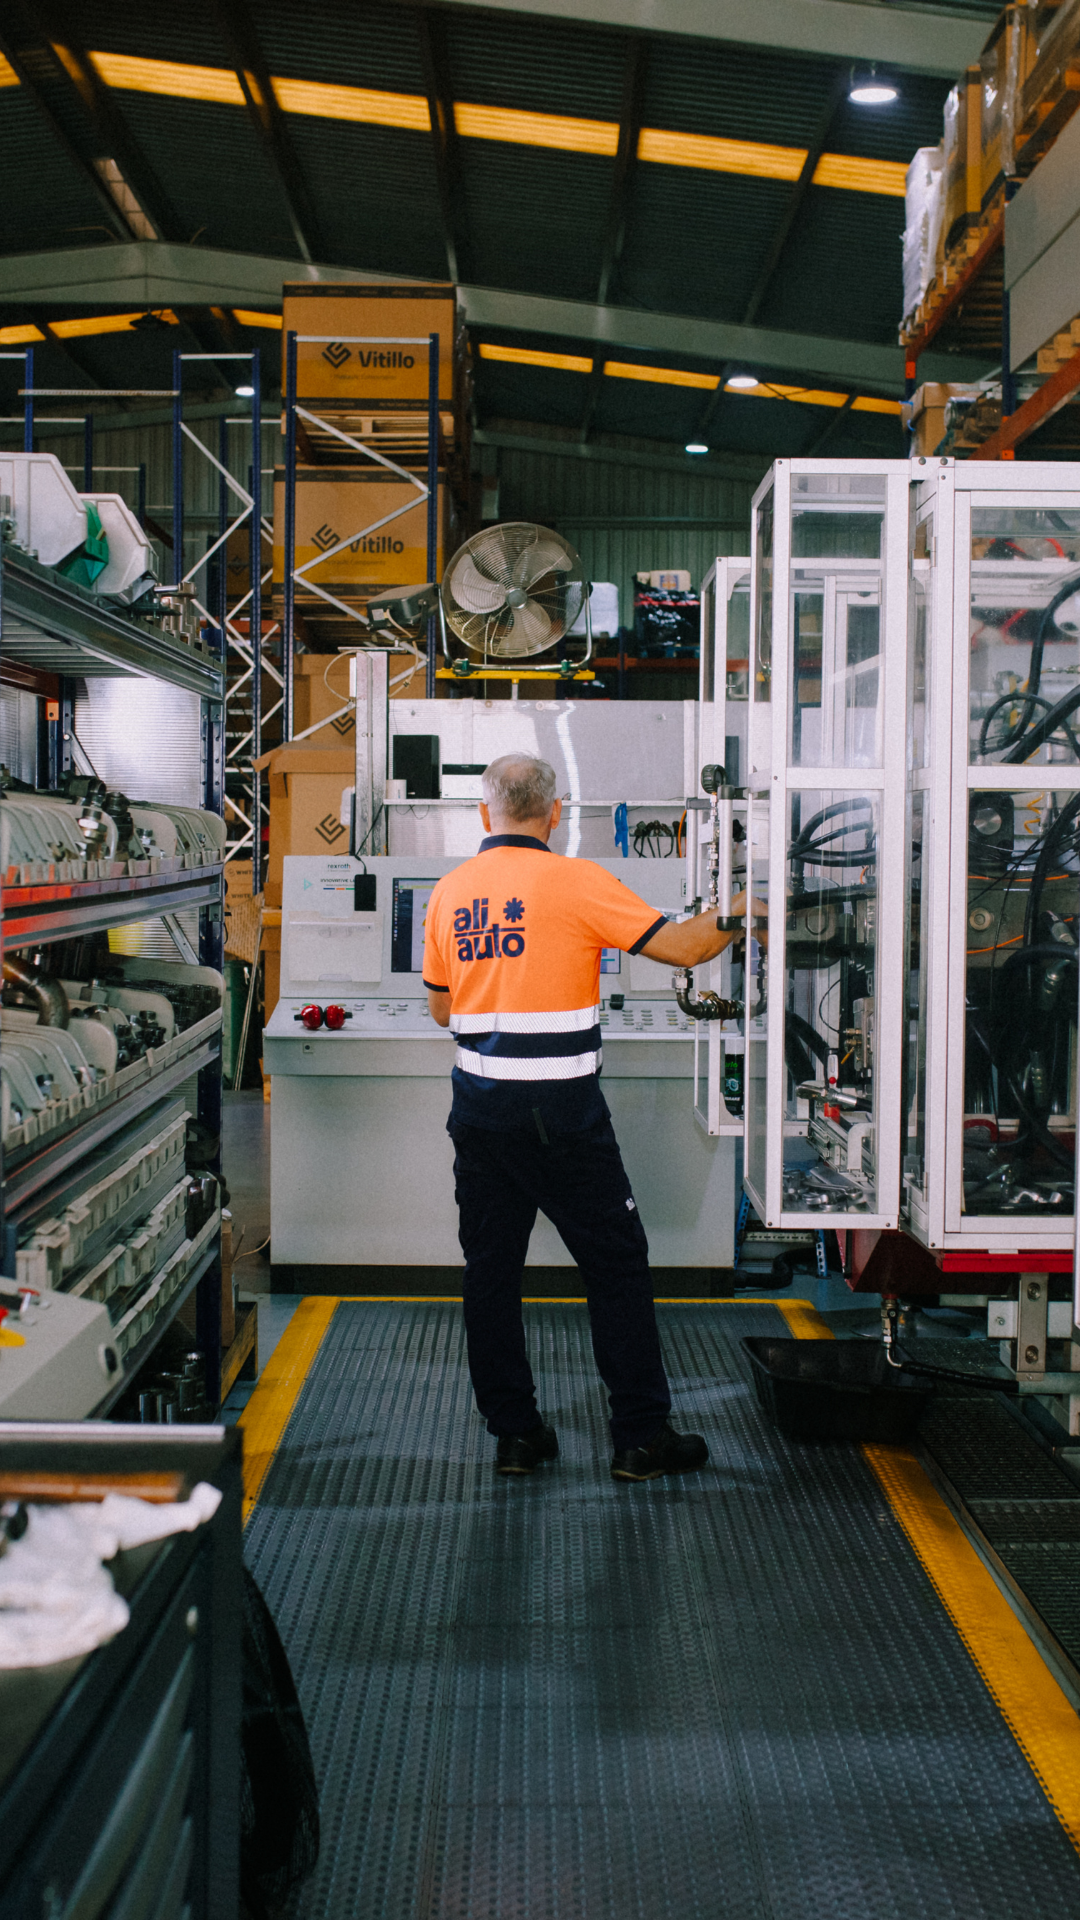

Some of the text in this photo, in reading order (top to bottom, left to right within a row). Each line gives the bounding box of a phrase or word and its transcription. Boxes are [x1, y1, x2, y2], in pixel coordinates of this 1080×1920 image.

[358, 350, 415, 369] Vitillo
[348, 535, 405, 554] Vitillo
[453, 897, 489, 932] ali
[456, 923, 525, 962] auto
